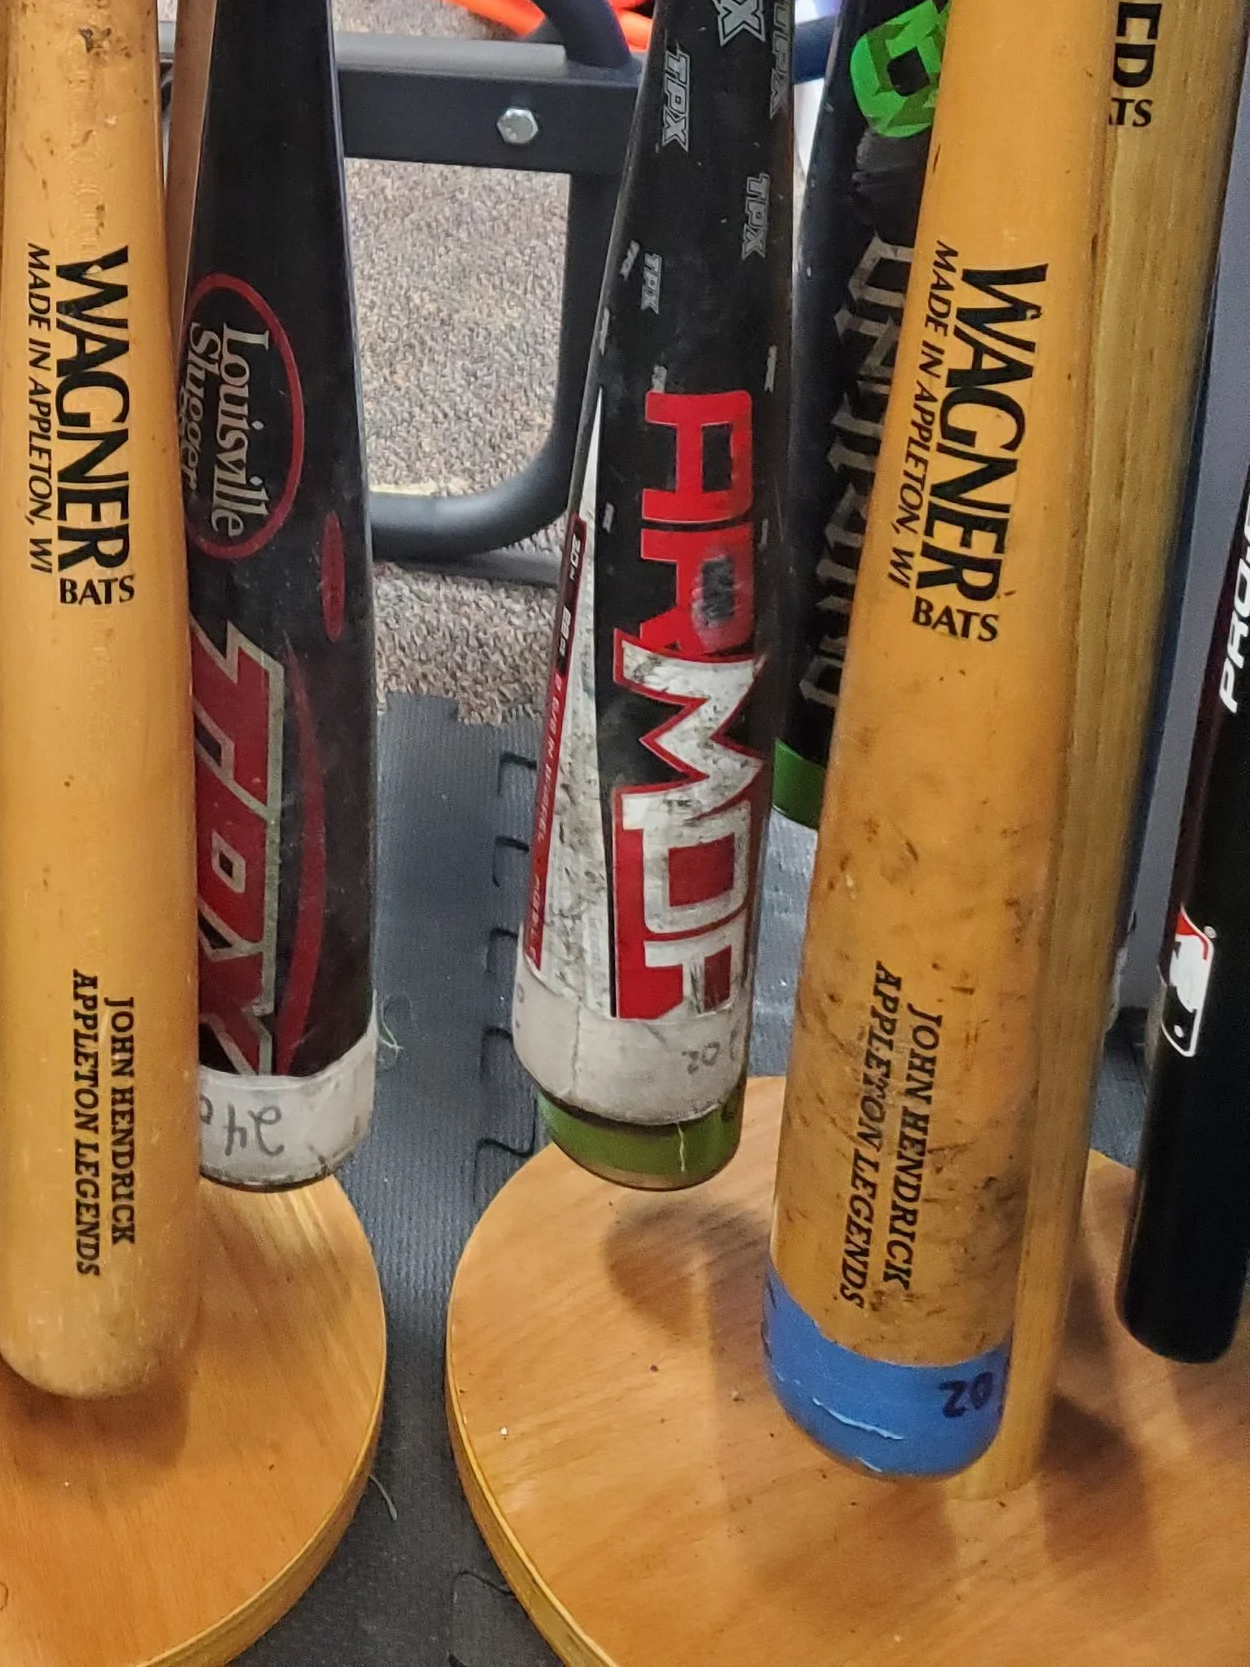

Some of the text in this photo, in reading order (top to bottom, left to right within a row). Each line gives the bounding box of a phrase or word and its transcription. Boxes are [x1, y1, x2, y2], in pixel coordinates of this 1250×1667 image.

[661, 46, 691, 153] TPX
[741, 173, 770, 260] TPX
[1108, 97, 1153, 127] TS
[640, 252, 662, 315] TPX
[24, 242, 52, 574] MADE IN APPLETON, WI
[55, 245, 130, 572] WAGNER
[210, 322, 270, 538] Louisville
[888, 239, 959, 589] MADE IN APPLETON, WI
[916, 263, 1049, 601] WAGNER
[60, 573, 135, 605] BATS
[912, 595, 999, 642] BATS
[73, 968, 100, 1277] APPLETON LEGENDS
[104, 997, 136, 1245] JOHN HENDRICK
[839, 960, 902, 1309] APPLETON LEGENDS
[883, 1002, 943, 1291] JOHN HENDRICK
